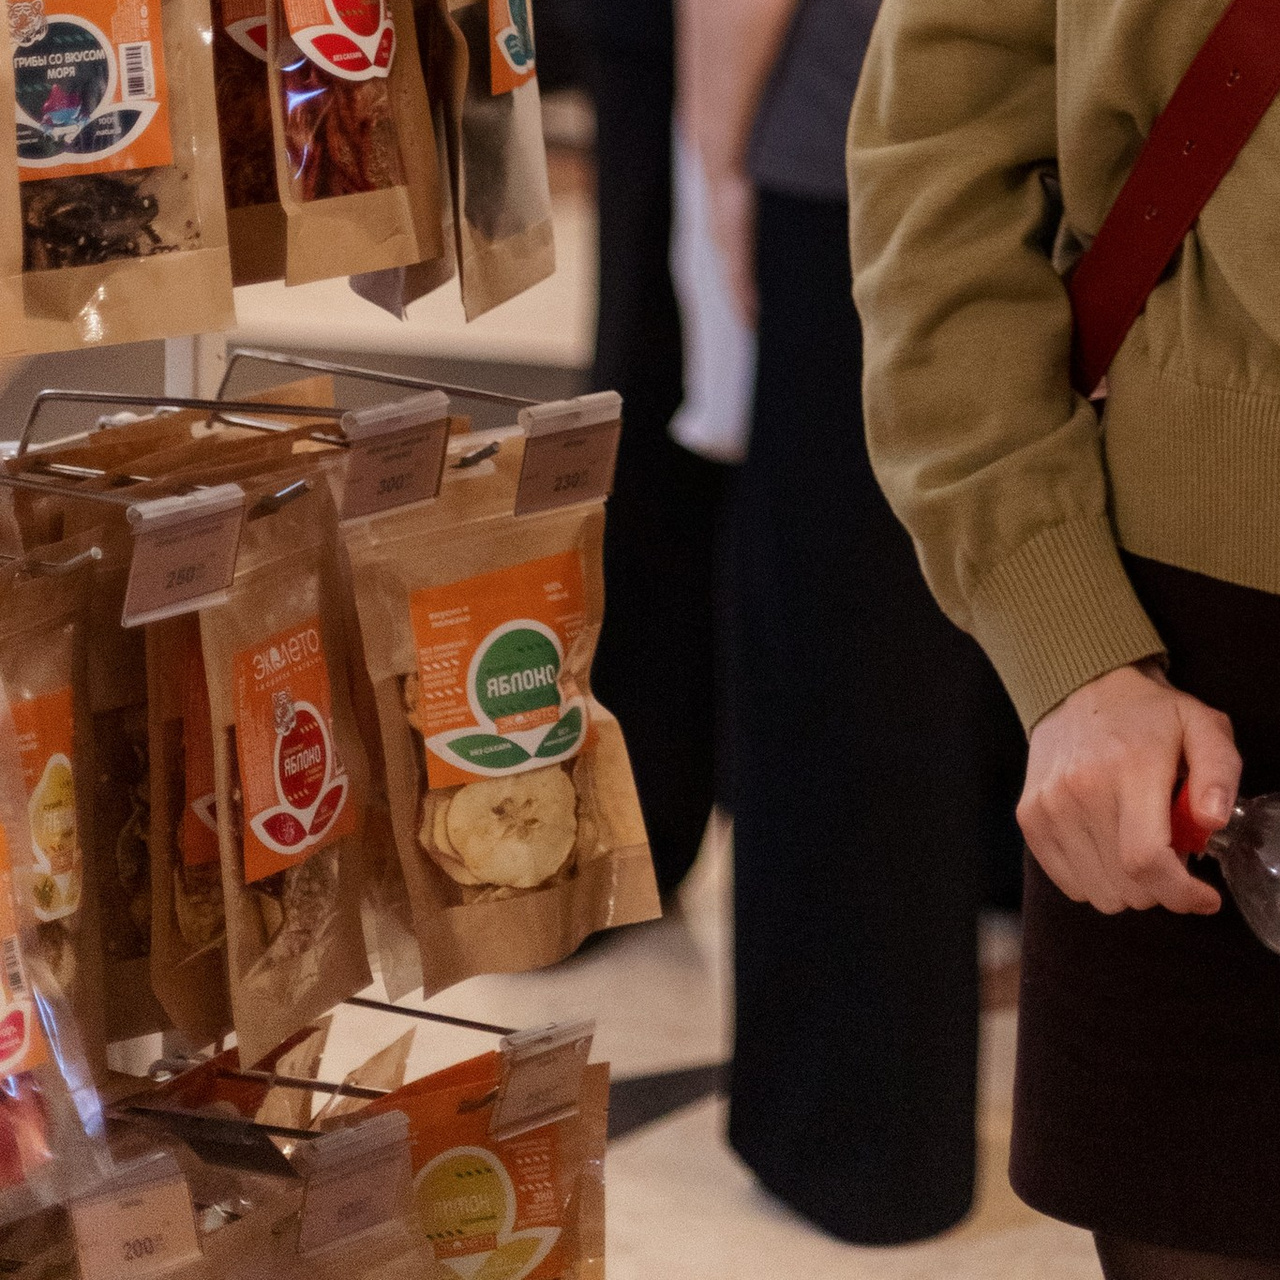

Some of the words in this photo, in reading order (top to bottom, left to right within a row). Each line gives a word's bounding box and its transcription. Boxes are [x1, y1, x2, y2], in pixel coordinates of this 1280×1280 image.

[14, 55, 47, 69] ГРИБЫ
[48, 53, 63, 65] СО
[65, 50, 106, 64] ВКУСОМ
[47, 67, 76, 80] МОРЯ
[486, 664, 556, 698] ЯБЛОКО
[284, 744, 322, 777] ЯБЛОКО
[123, 1237, 154, 1261] 200
